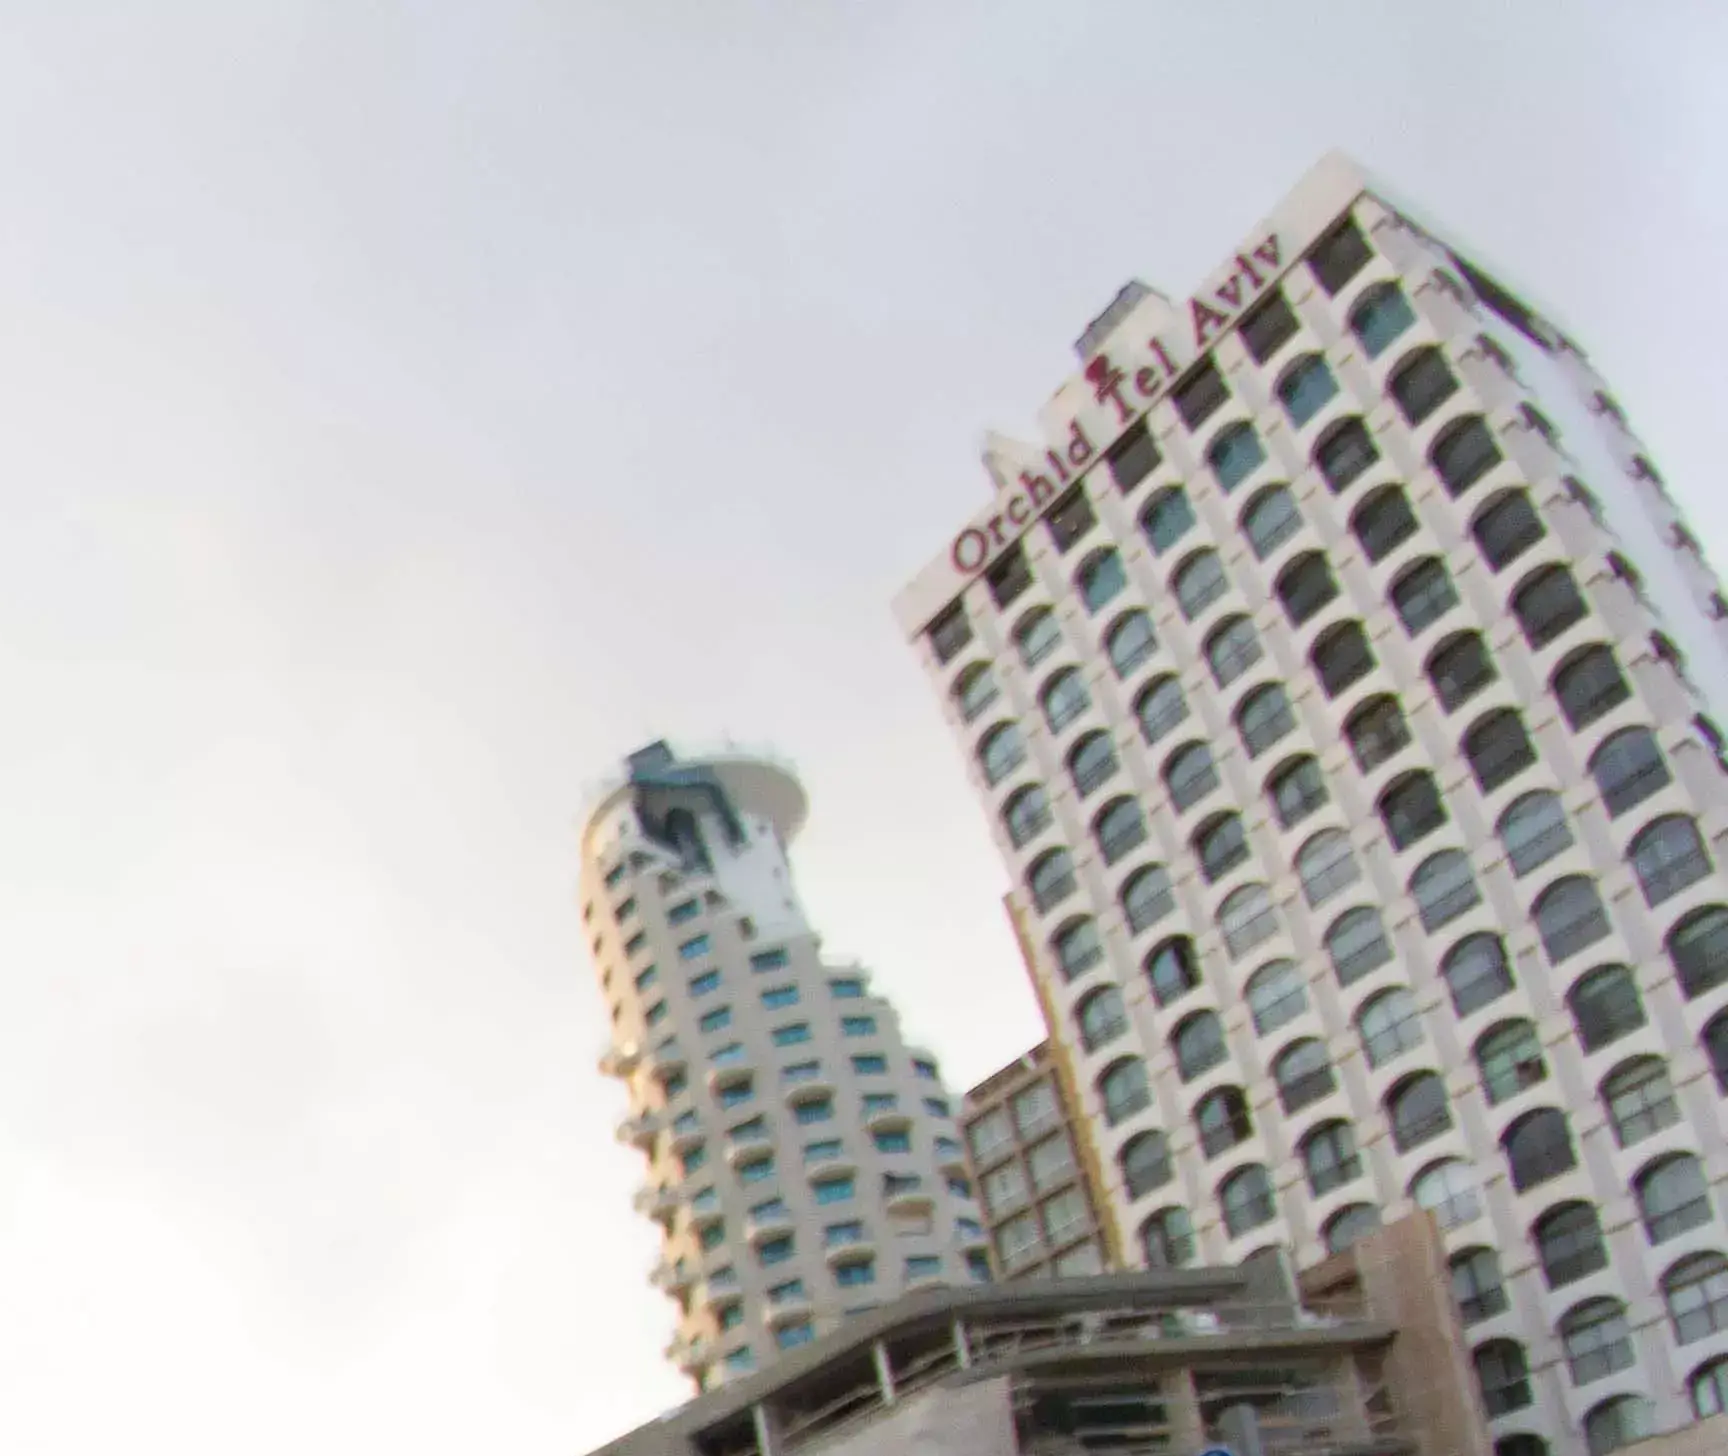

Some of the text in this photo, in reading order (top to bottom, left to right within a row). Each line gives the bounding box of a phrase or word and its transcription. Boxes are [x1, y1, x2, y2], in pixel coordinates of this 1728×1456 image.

[950, 232, 1281, 573] Orchid Tel Aviv
